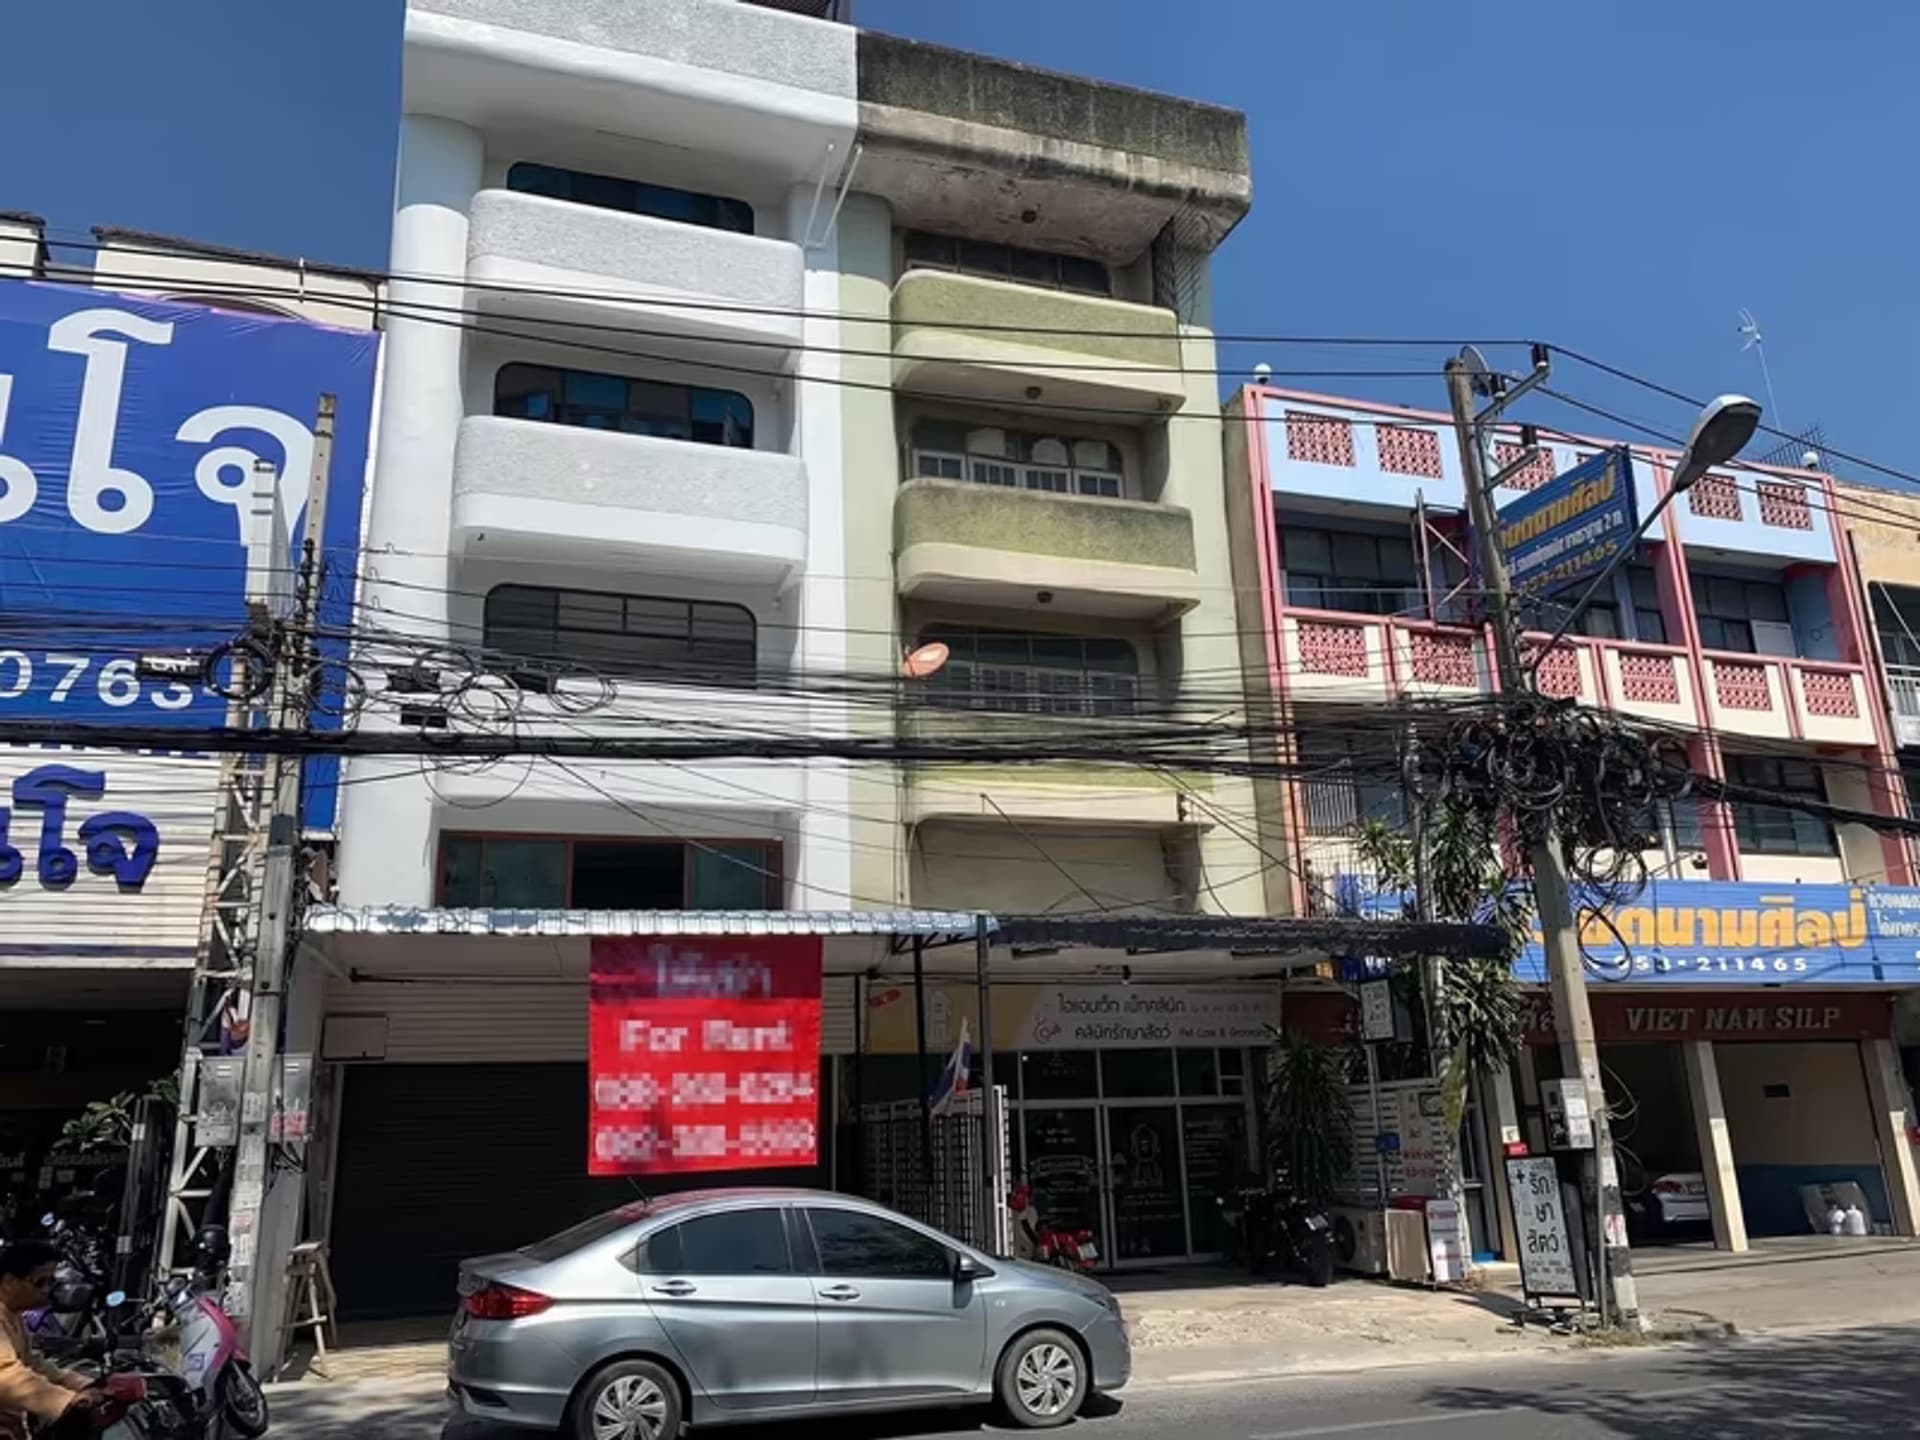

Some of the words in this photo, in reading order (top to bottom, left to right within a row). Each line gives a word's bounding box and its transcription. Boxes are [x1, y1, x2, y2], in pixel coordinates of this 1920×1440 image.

[0, 763, 159, 894] โจ
[1626, 1007, 1694, 1031] VIET
[1705, 1007, 1767, 1030] NAM
[1775, 1006, 1841, 1029] SILP
